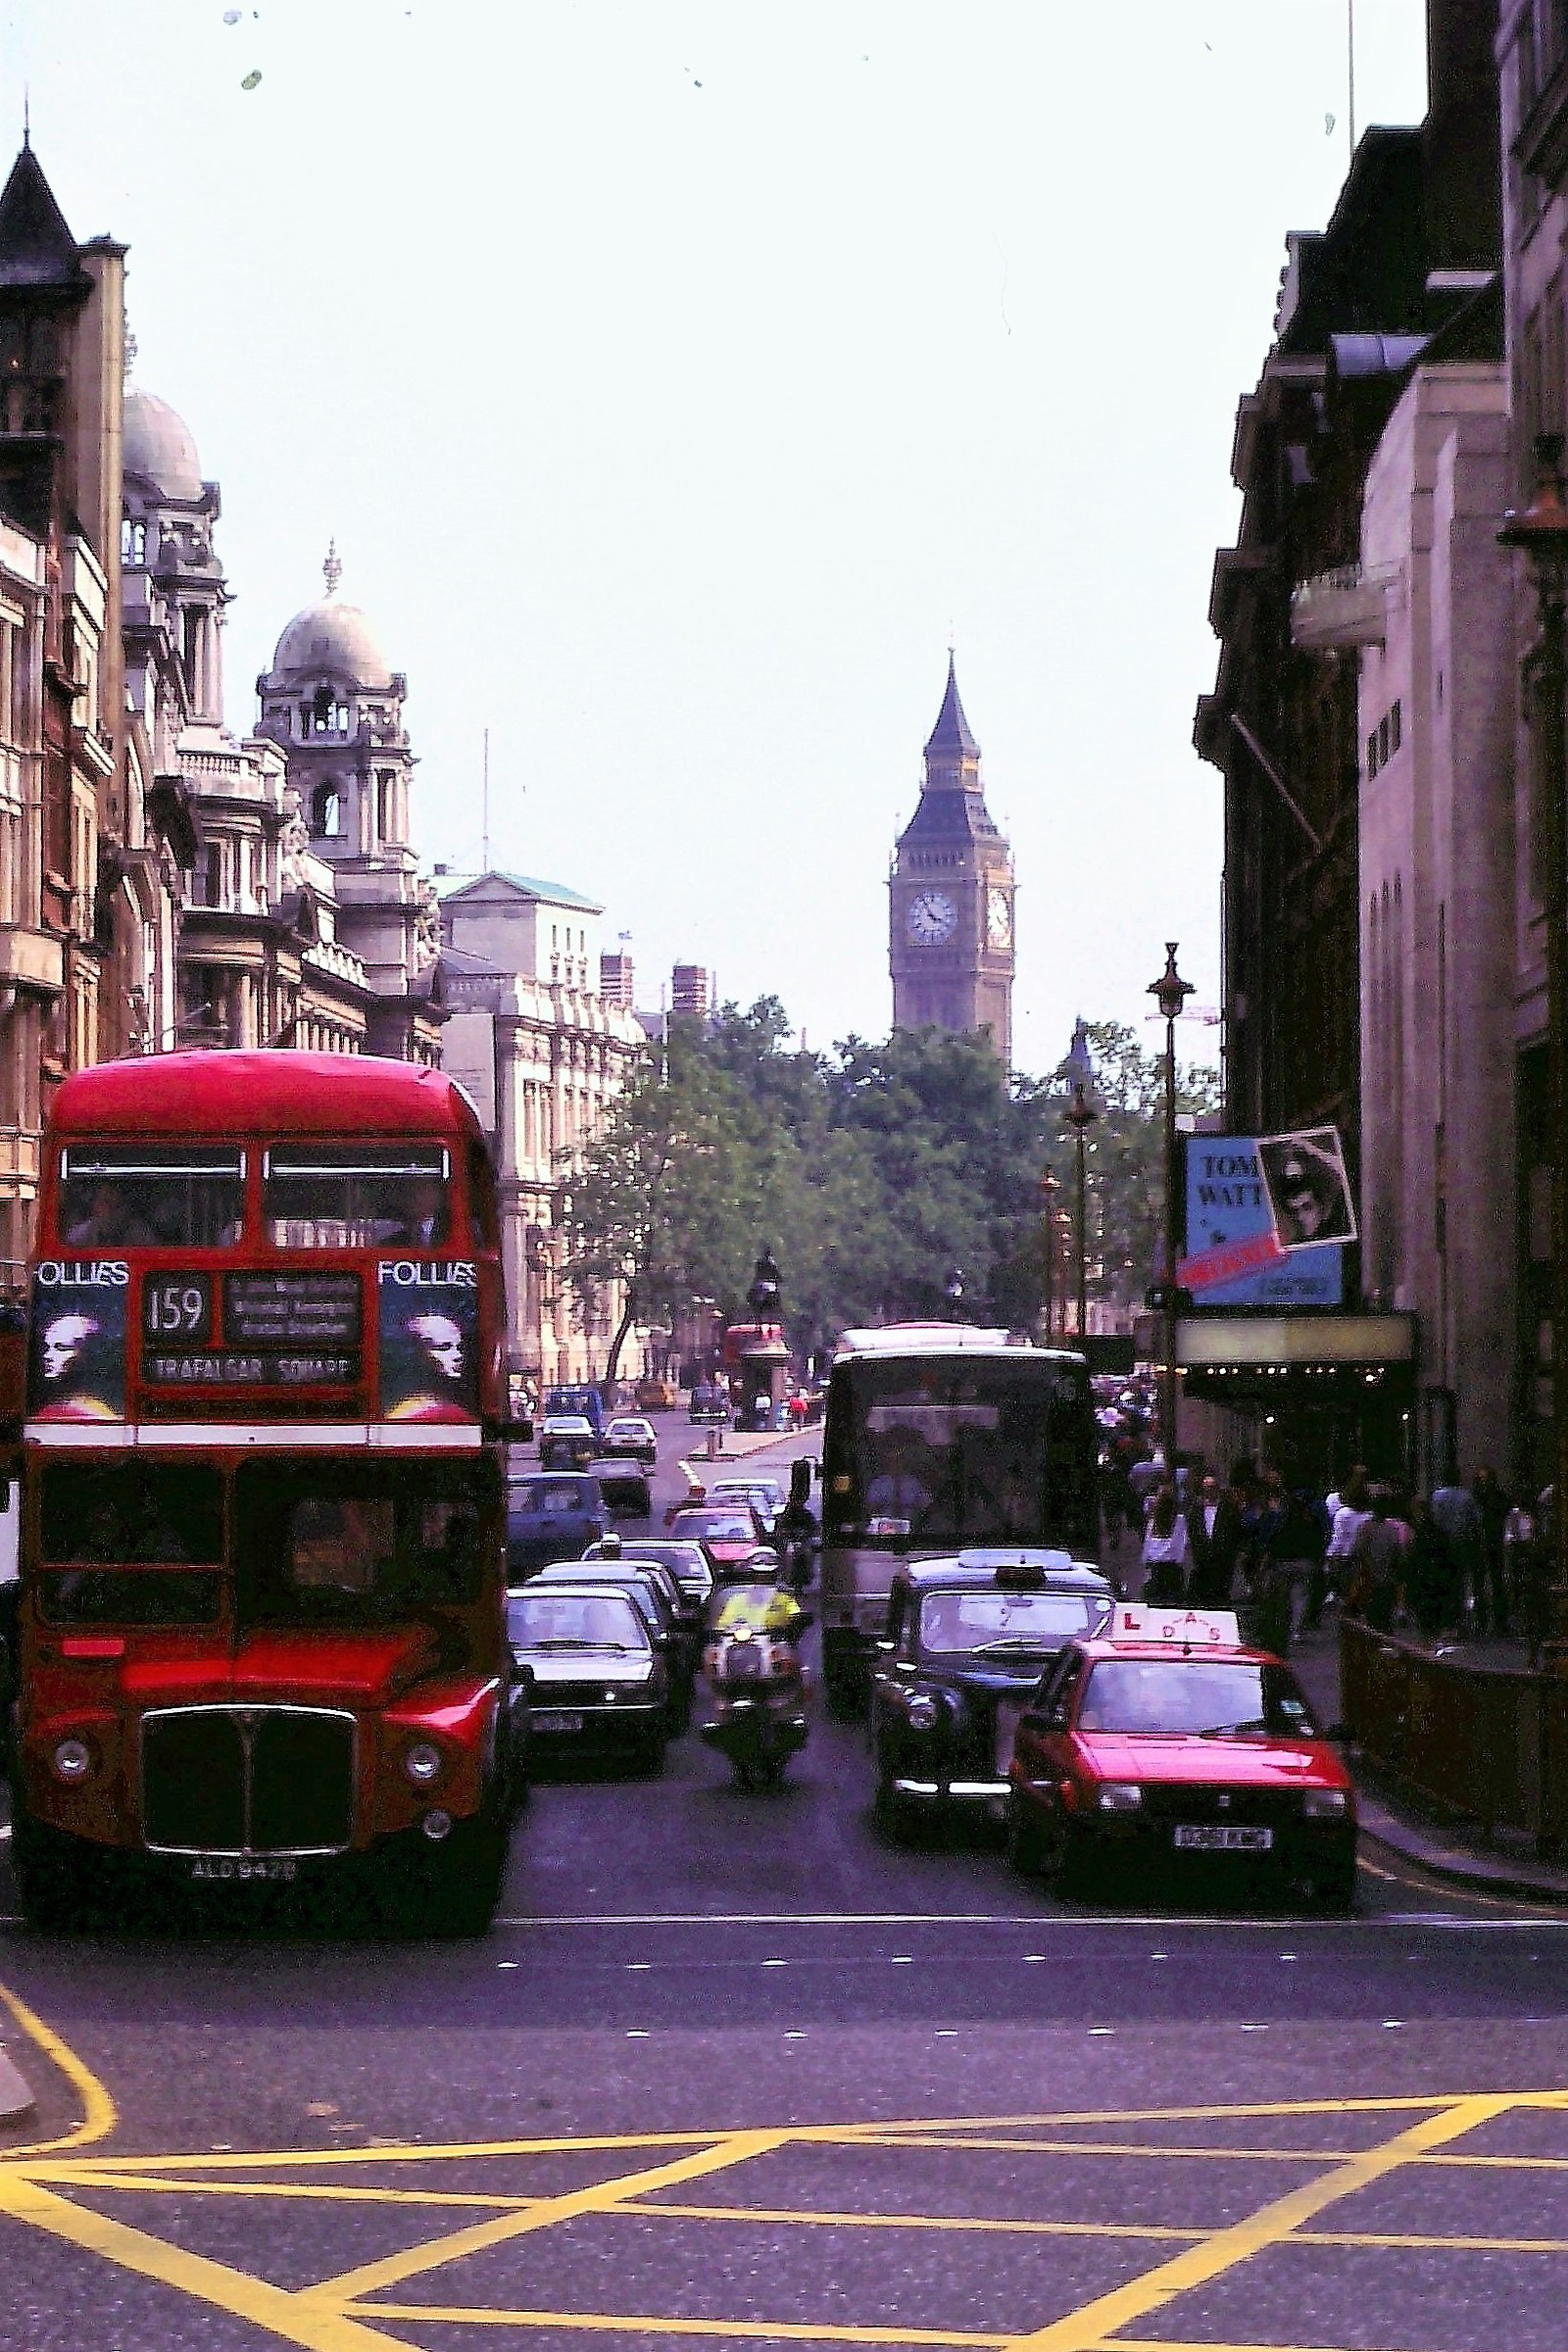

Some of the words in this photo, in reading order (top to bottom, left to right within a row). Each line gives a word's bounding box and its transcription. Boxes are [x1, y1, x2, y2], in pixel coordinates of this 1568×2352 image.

[33, 1261, 129, 1286] OLLIES
[151, 1288, 203, 1330] 159
[1124, 1612, 1142, 1631] L
